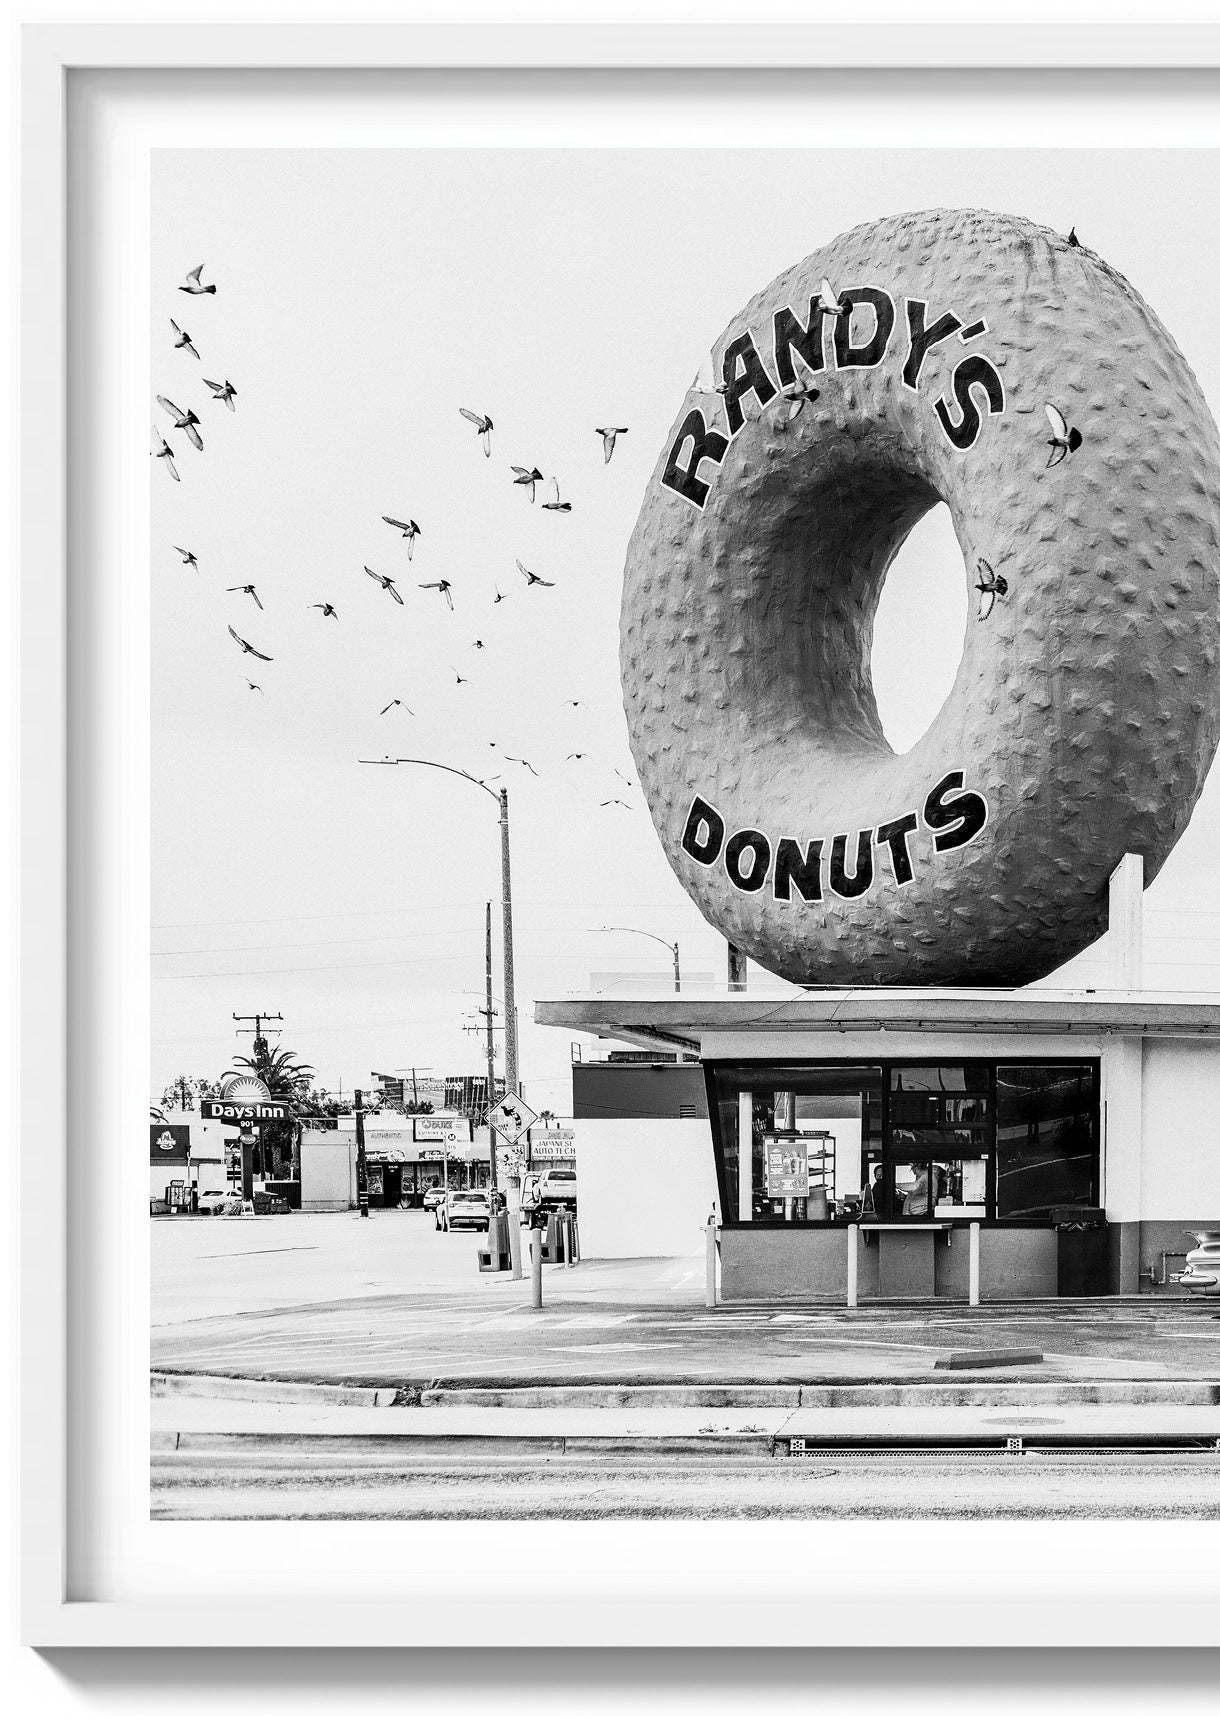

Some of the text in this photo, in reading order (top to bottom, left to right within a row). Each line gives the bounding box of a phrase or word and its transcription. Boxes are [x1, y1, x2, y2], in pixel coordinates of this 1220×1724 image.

[661, 285, 1006, 511] RANDY'S
[681, 768, 989, 903] DONUTS
[211, 1103, 285, 1118] Days Inn
[533, 1147, 576, 1155] AUTO TECH
